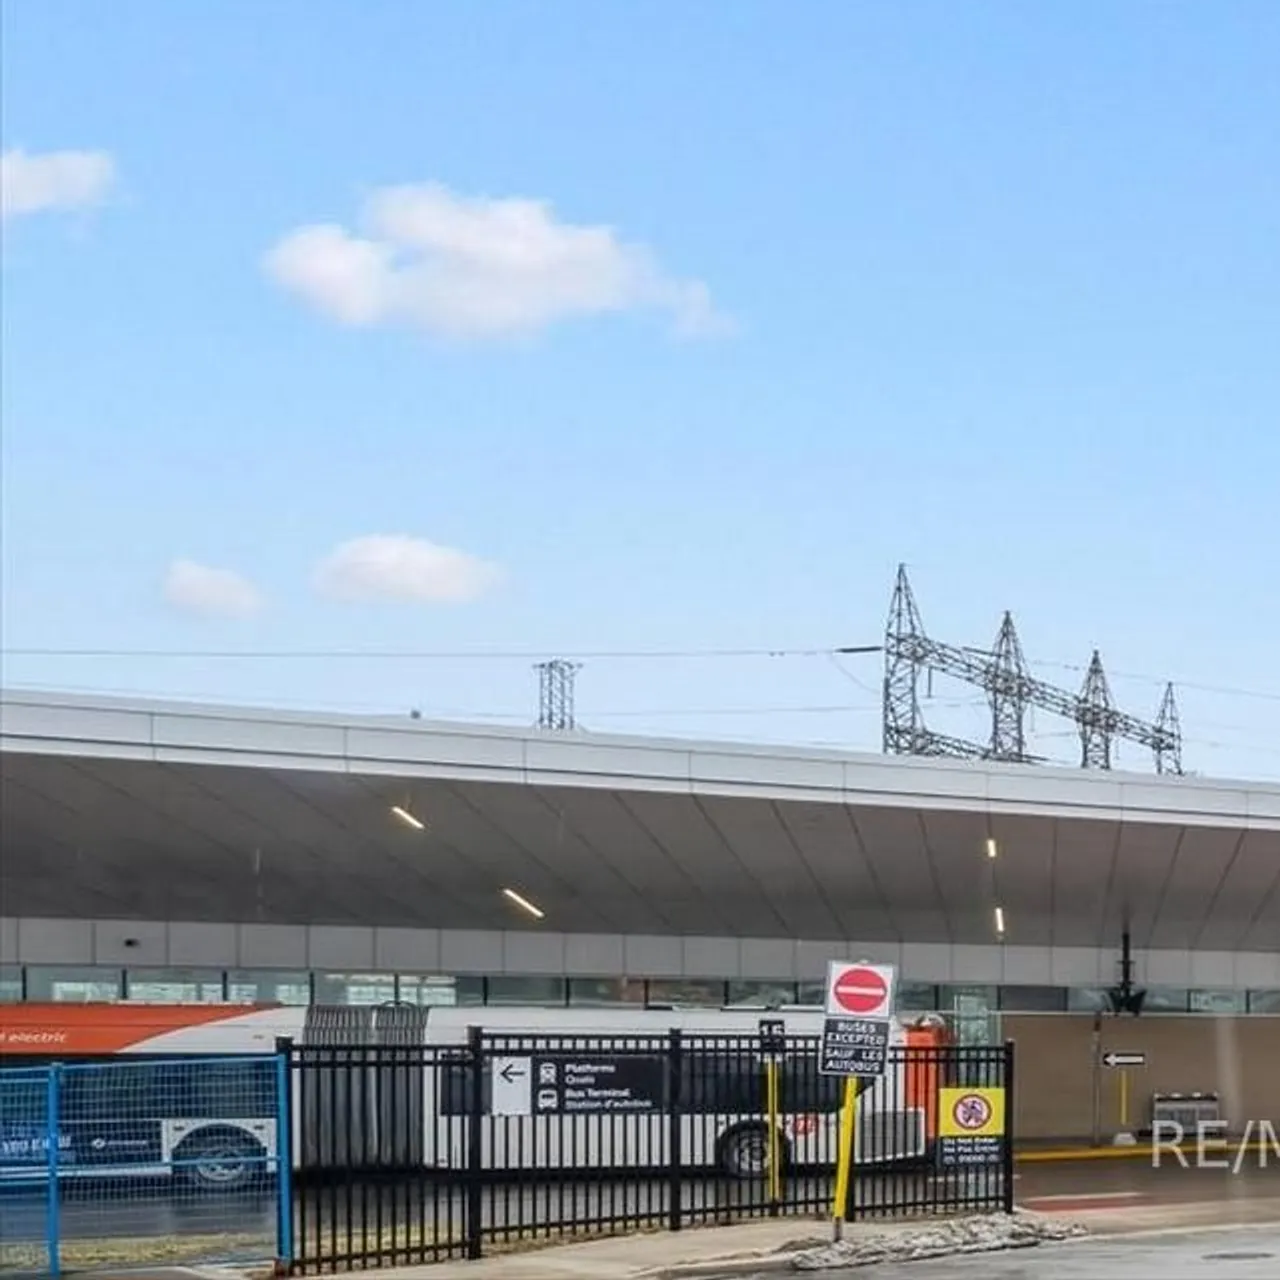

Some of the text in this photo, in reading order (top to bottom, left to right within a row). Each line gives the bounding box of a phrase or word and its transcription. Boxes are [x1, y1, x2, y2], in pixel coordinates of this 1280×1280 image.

[837, 1022, 877, 1033] BUSES
[9, 1031, 66, 1043] electric
[826, 1032, 886, 1045] EXCEPTED
[825, 1047, 883, 1060] SAUF LES
[565, 1064, 616, 1073] Platforms
[825, 1060, 880, 1072] AUTOBUS
[565, 1088, 630, 1098] Bus Terminal
[565, 1100, 602, 1110] Station
